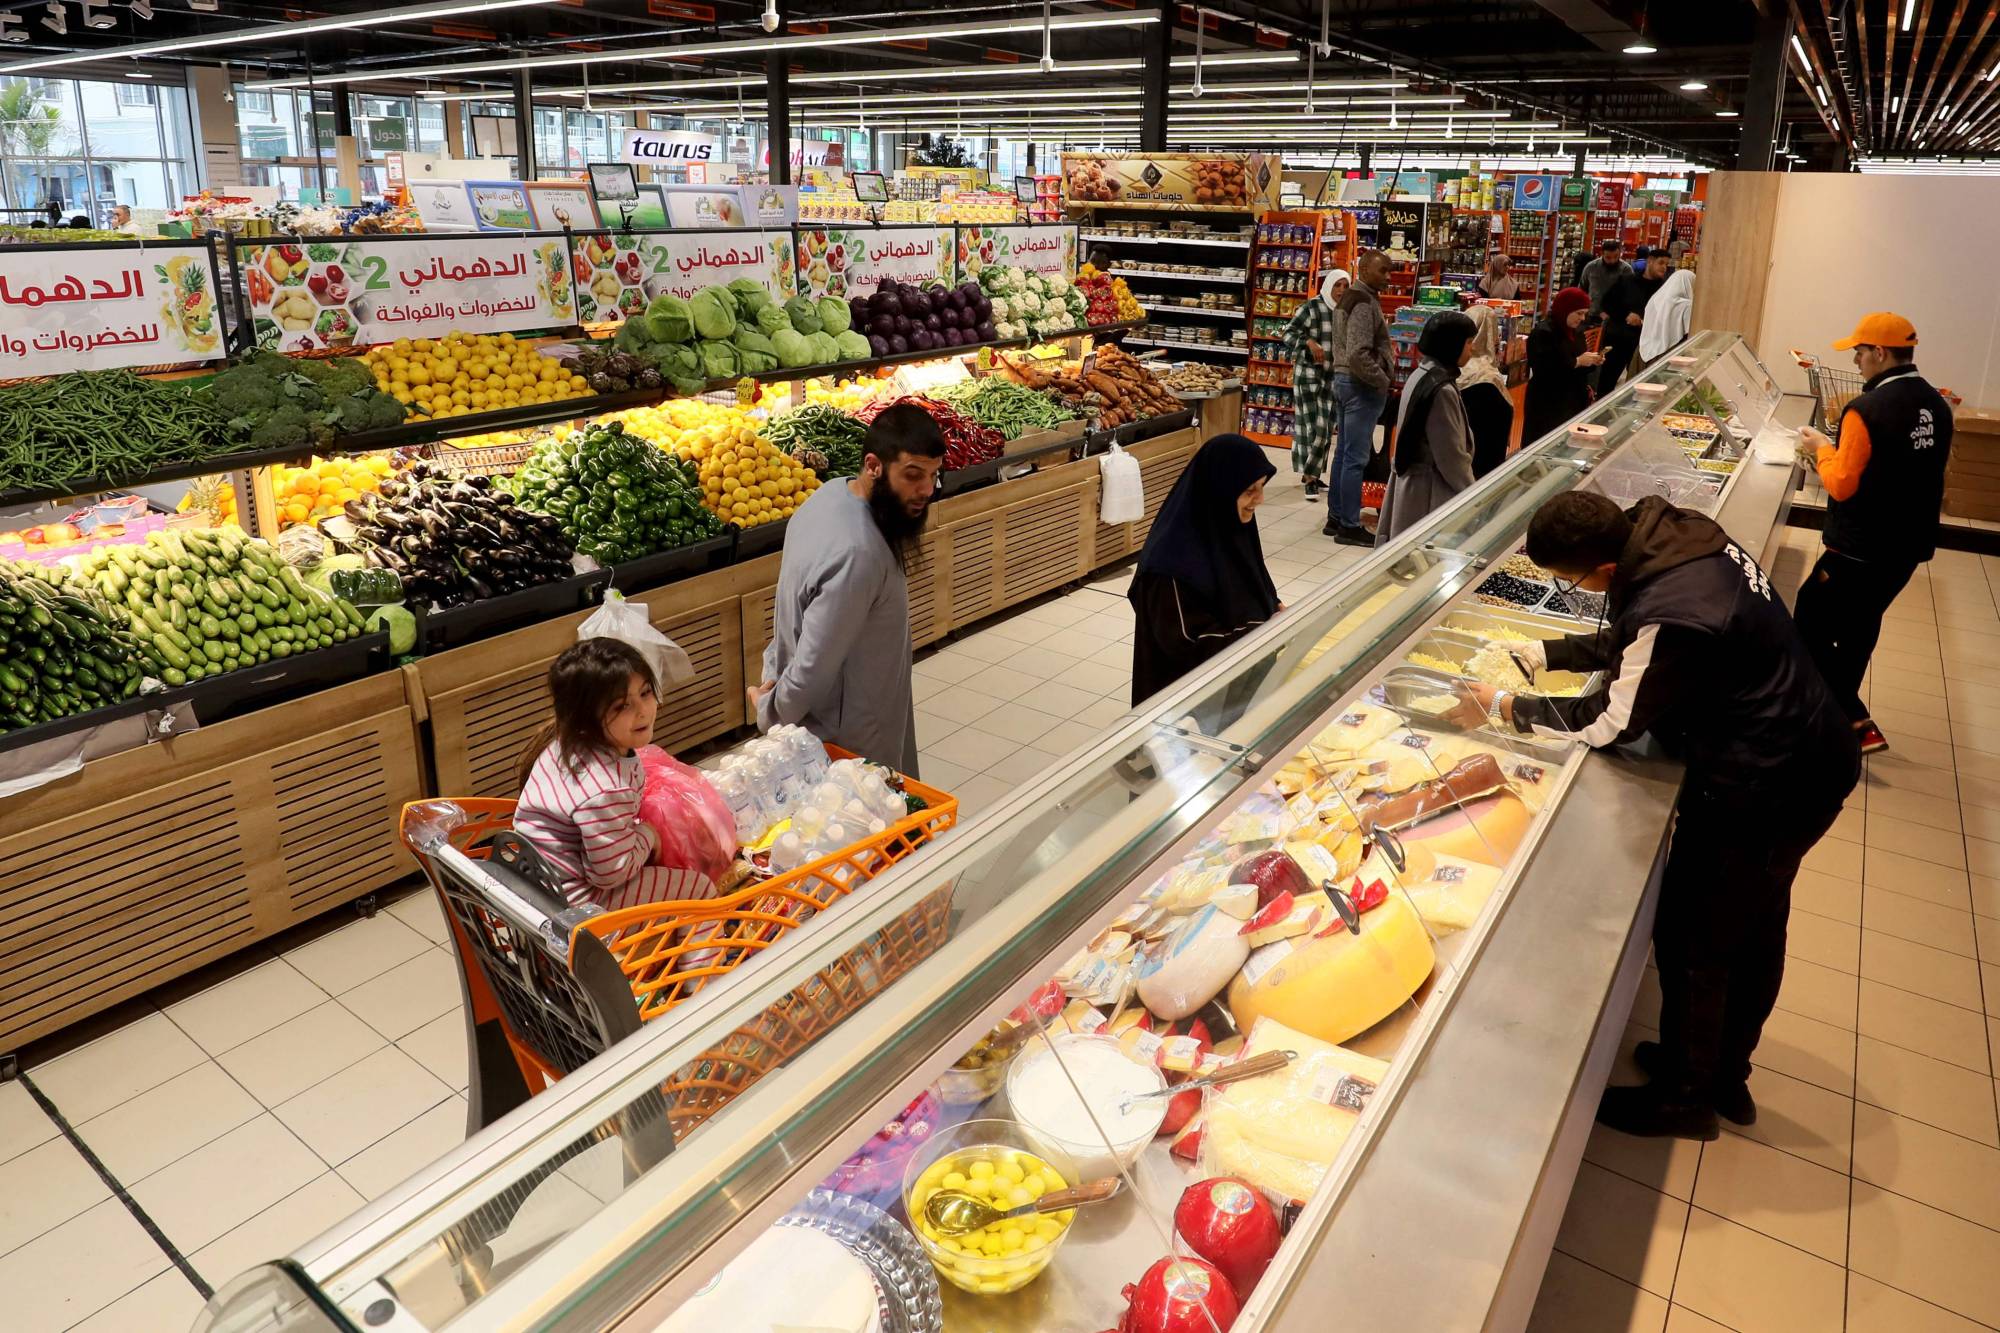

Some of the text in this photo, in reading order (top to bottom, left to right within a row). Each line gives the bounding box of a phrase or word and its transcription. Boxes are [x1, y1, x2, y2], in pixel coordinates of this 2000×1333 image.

[374, 129, 402, 142] دخول
[632, 136, 712, 159] taurus
[1153, 191, 1183, 202] حلويات
[651, 245, 764, 278] الدهماني 2
[853, 239, 933, 267] الدهماني 2
[1000, 236, 1060, 259] الدهماني 2
[361, 253, 527, 294] الدهماني 2
[376, 295, 536, 323] للخضروات والفواكة
[32, 323, 159, 352] للخضروات
